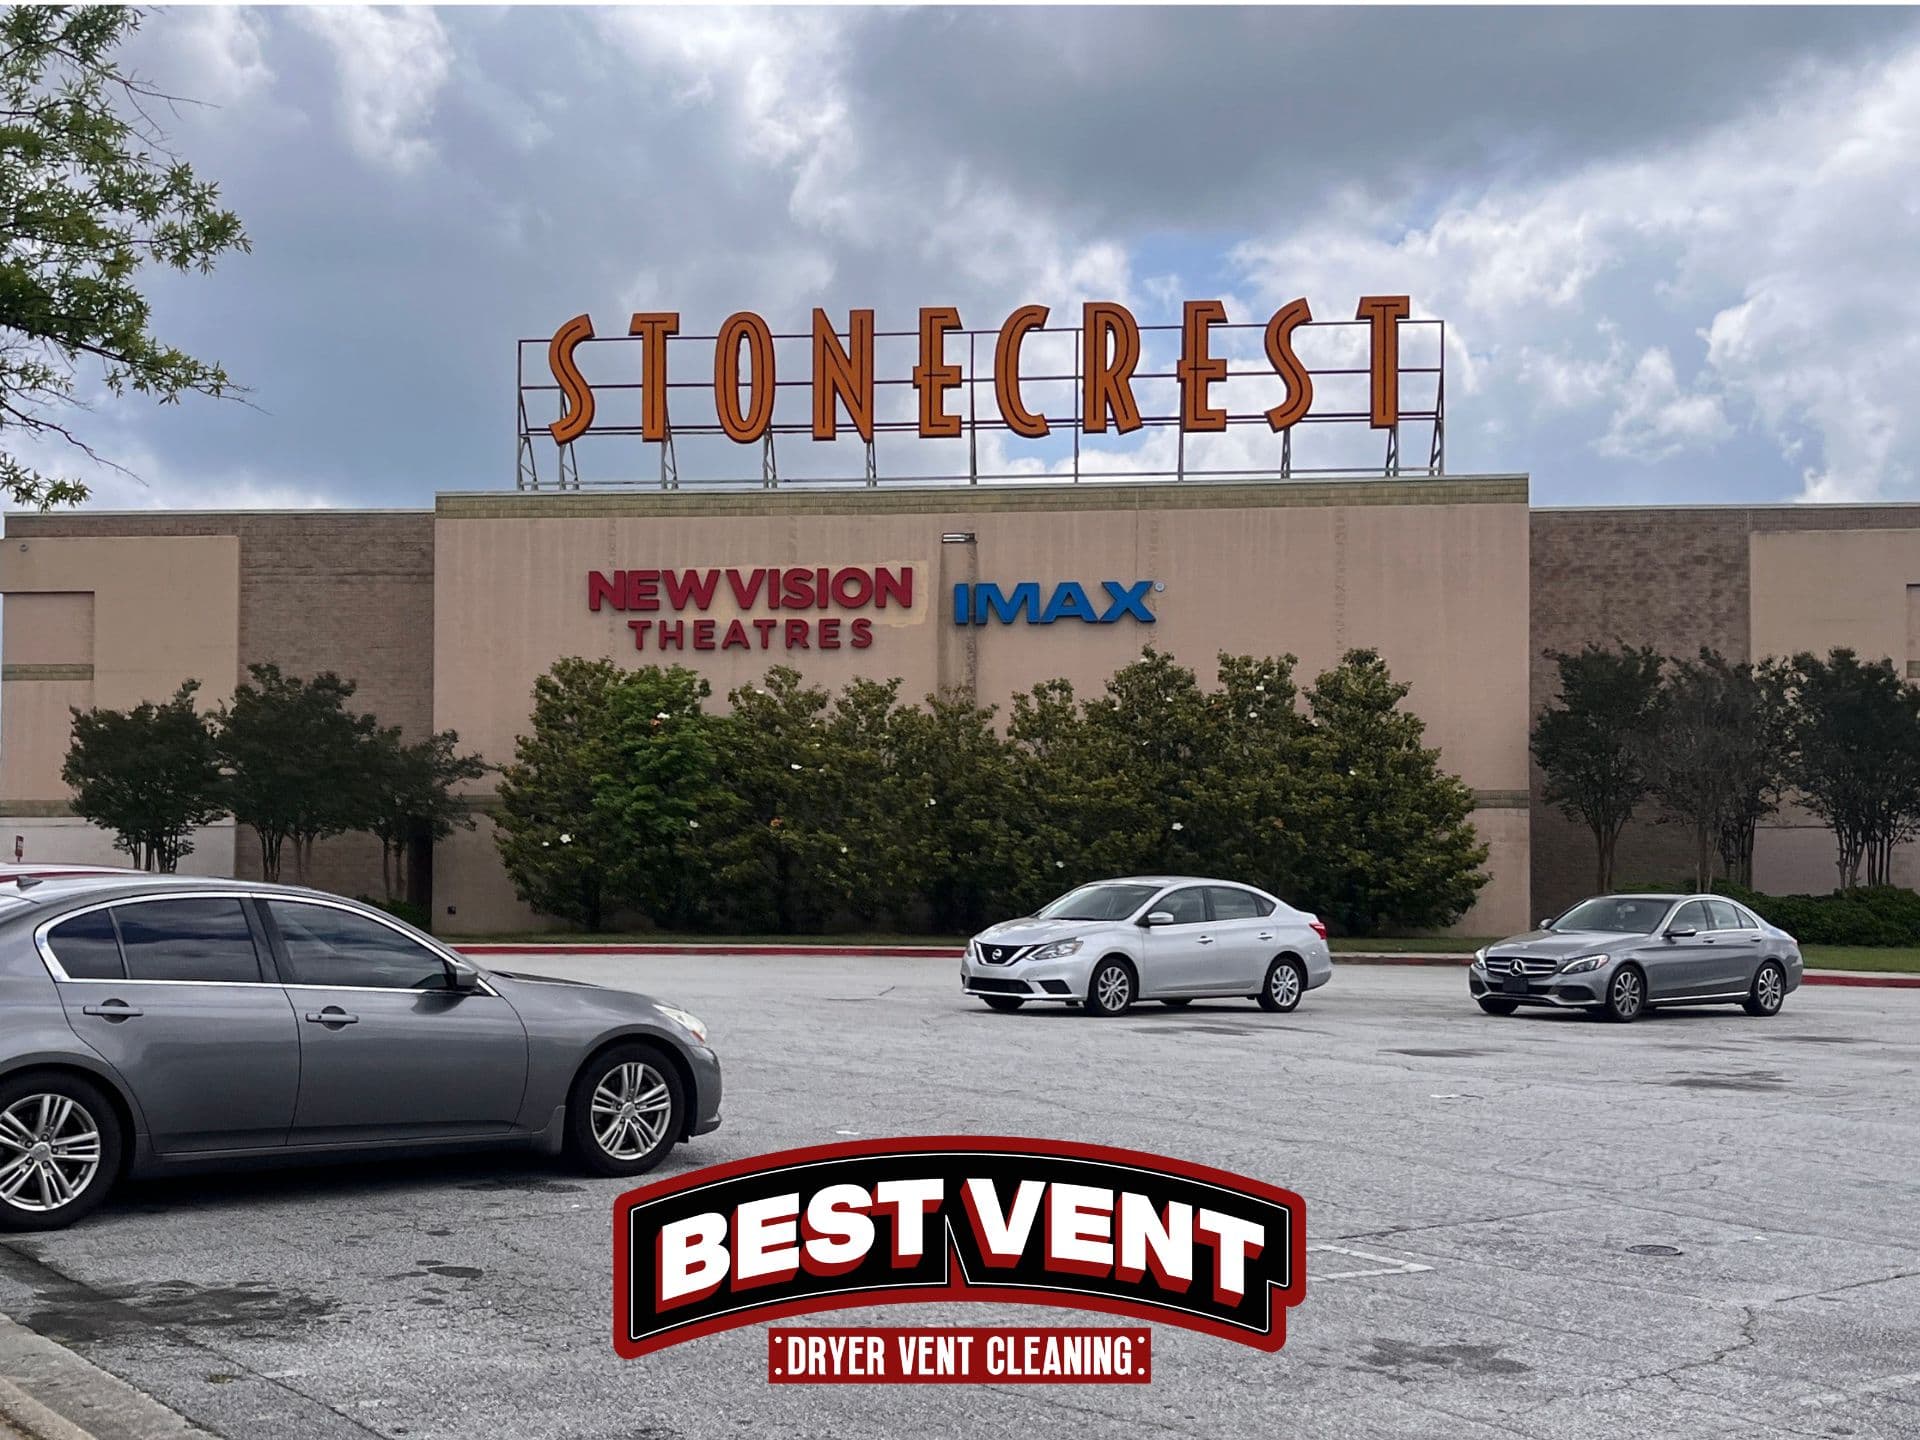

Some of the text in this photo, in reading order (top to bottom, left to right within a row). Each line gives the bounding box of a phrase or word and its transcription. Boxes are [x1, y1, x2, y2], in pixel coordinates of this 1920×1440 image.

[549, 296, 1411, 445] STONECREST
[954, 581, 1157, 625] IMAX
[627, 618, 873, 650] THEATRES
